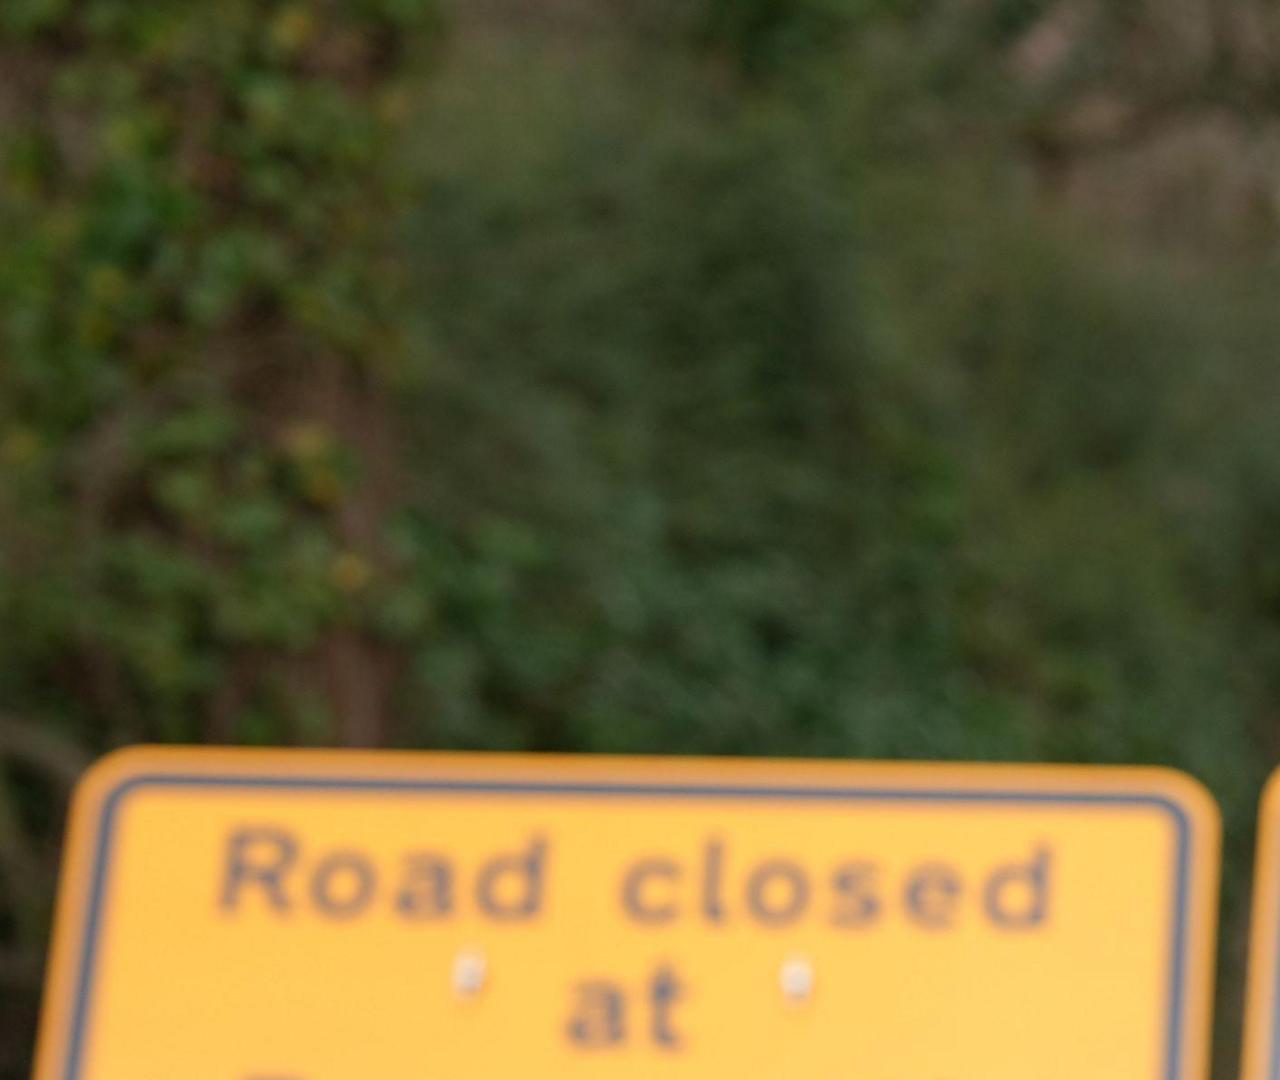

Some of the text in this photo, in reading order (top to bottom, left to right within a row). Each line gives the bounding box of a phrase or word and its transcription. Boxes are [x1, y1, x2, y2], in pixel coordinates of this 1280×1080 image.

[218, 826, 1052, 930] Road closed
[564, 964, 684, 1050] at
